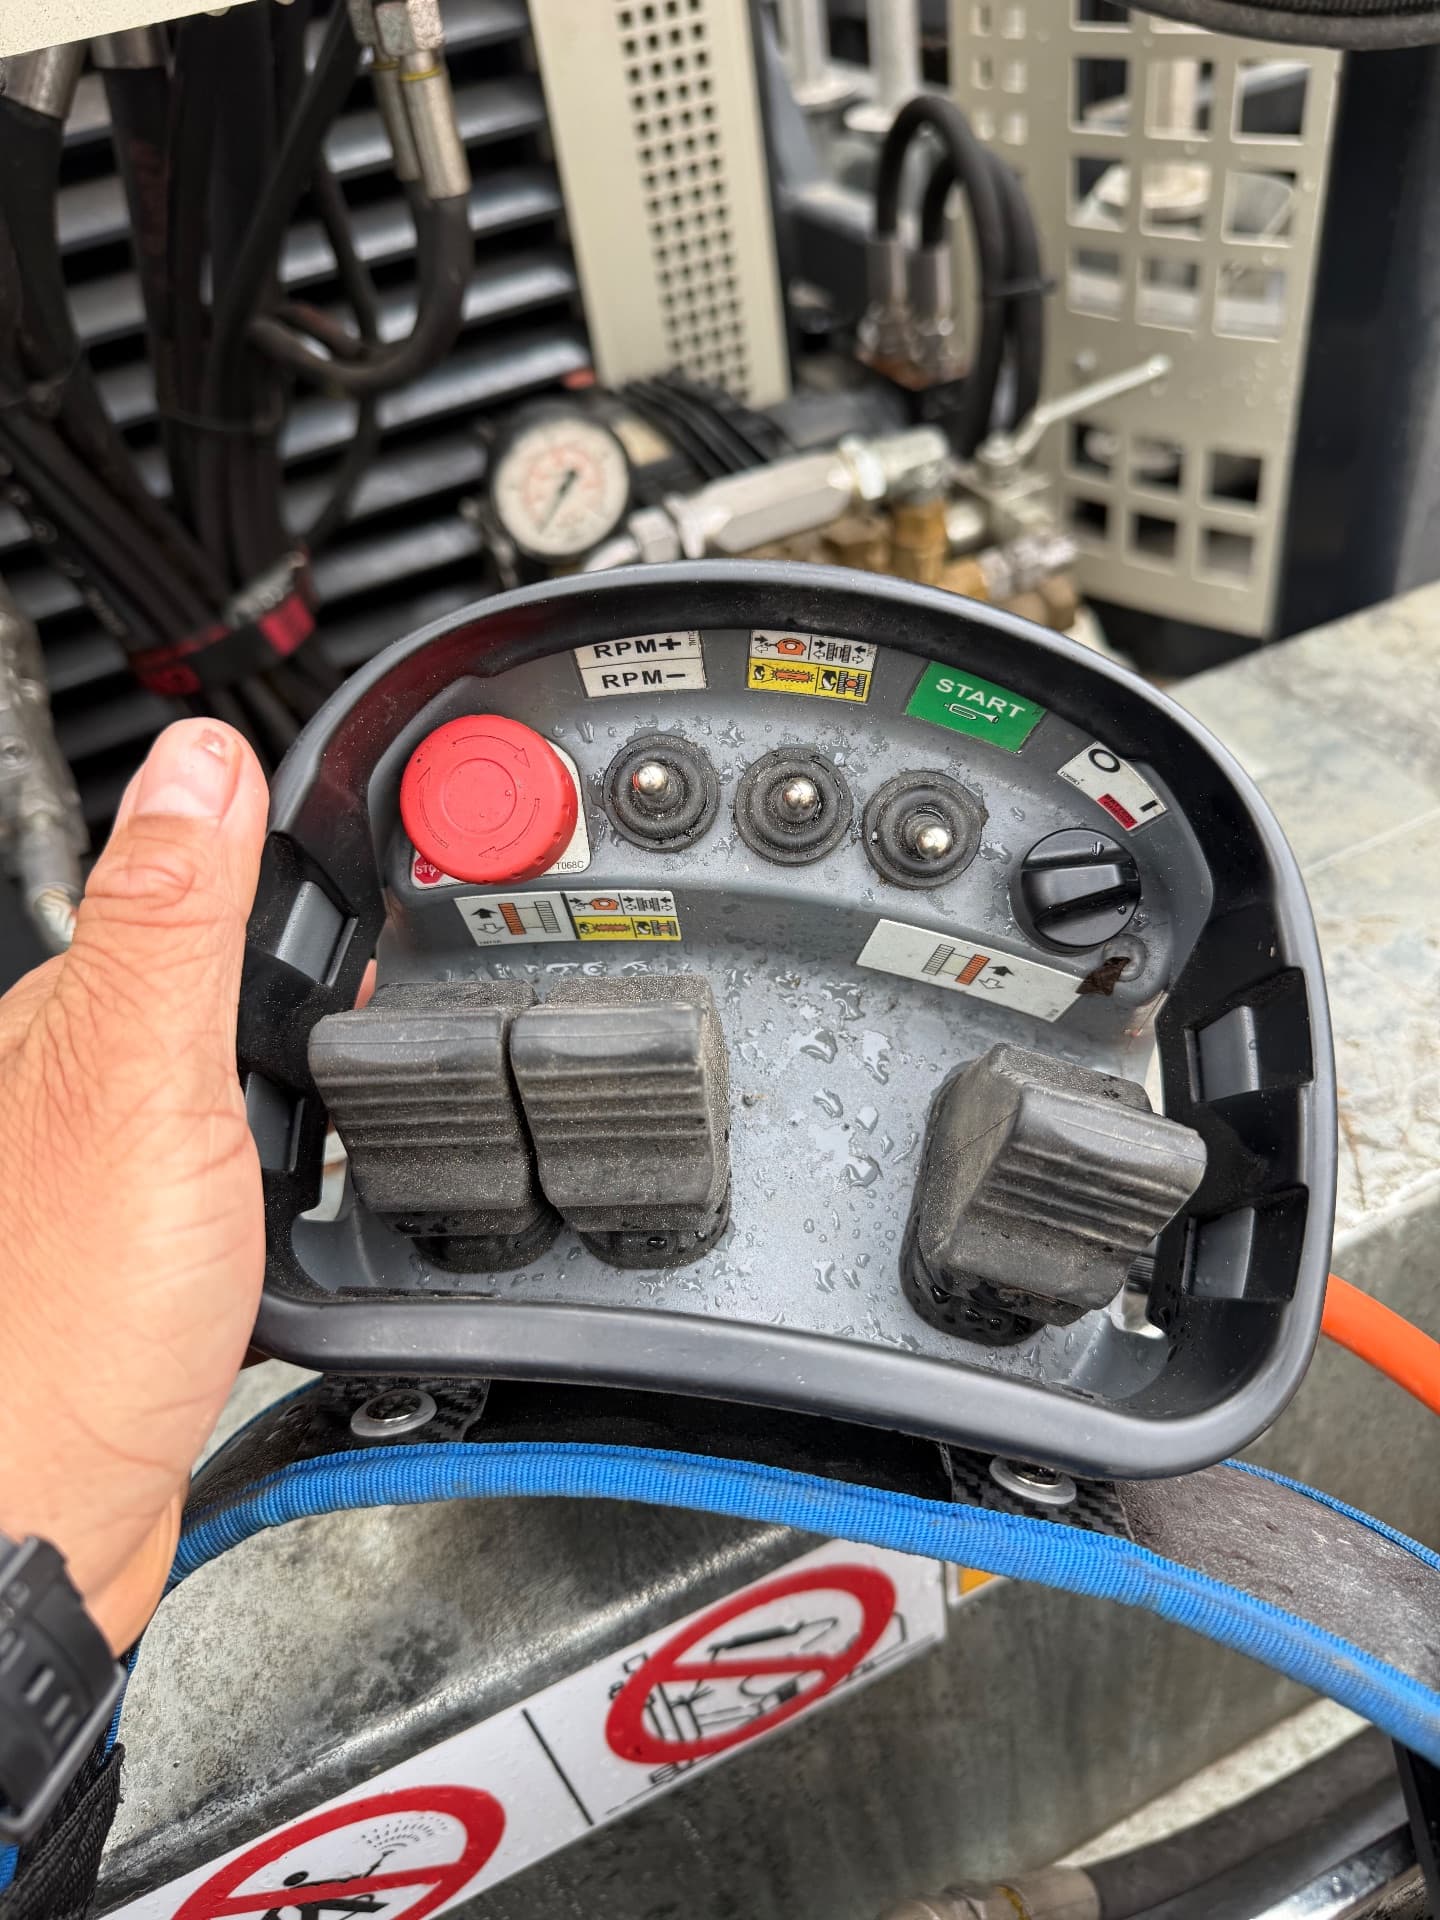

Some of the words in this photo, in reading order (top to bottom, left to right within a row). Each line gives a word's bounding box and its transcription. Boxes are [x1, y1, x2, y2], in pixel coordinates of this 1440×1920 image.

[593, 638, 682, 659] RPM+
[935, 678, 1026, 718] START
[415, 863, 440, 875] STO
